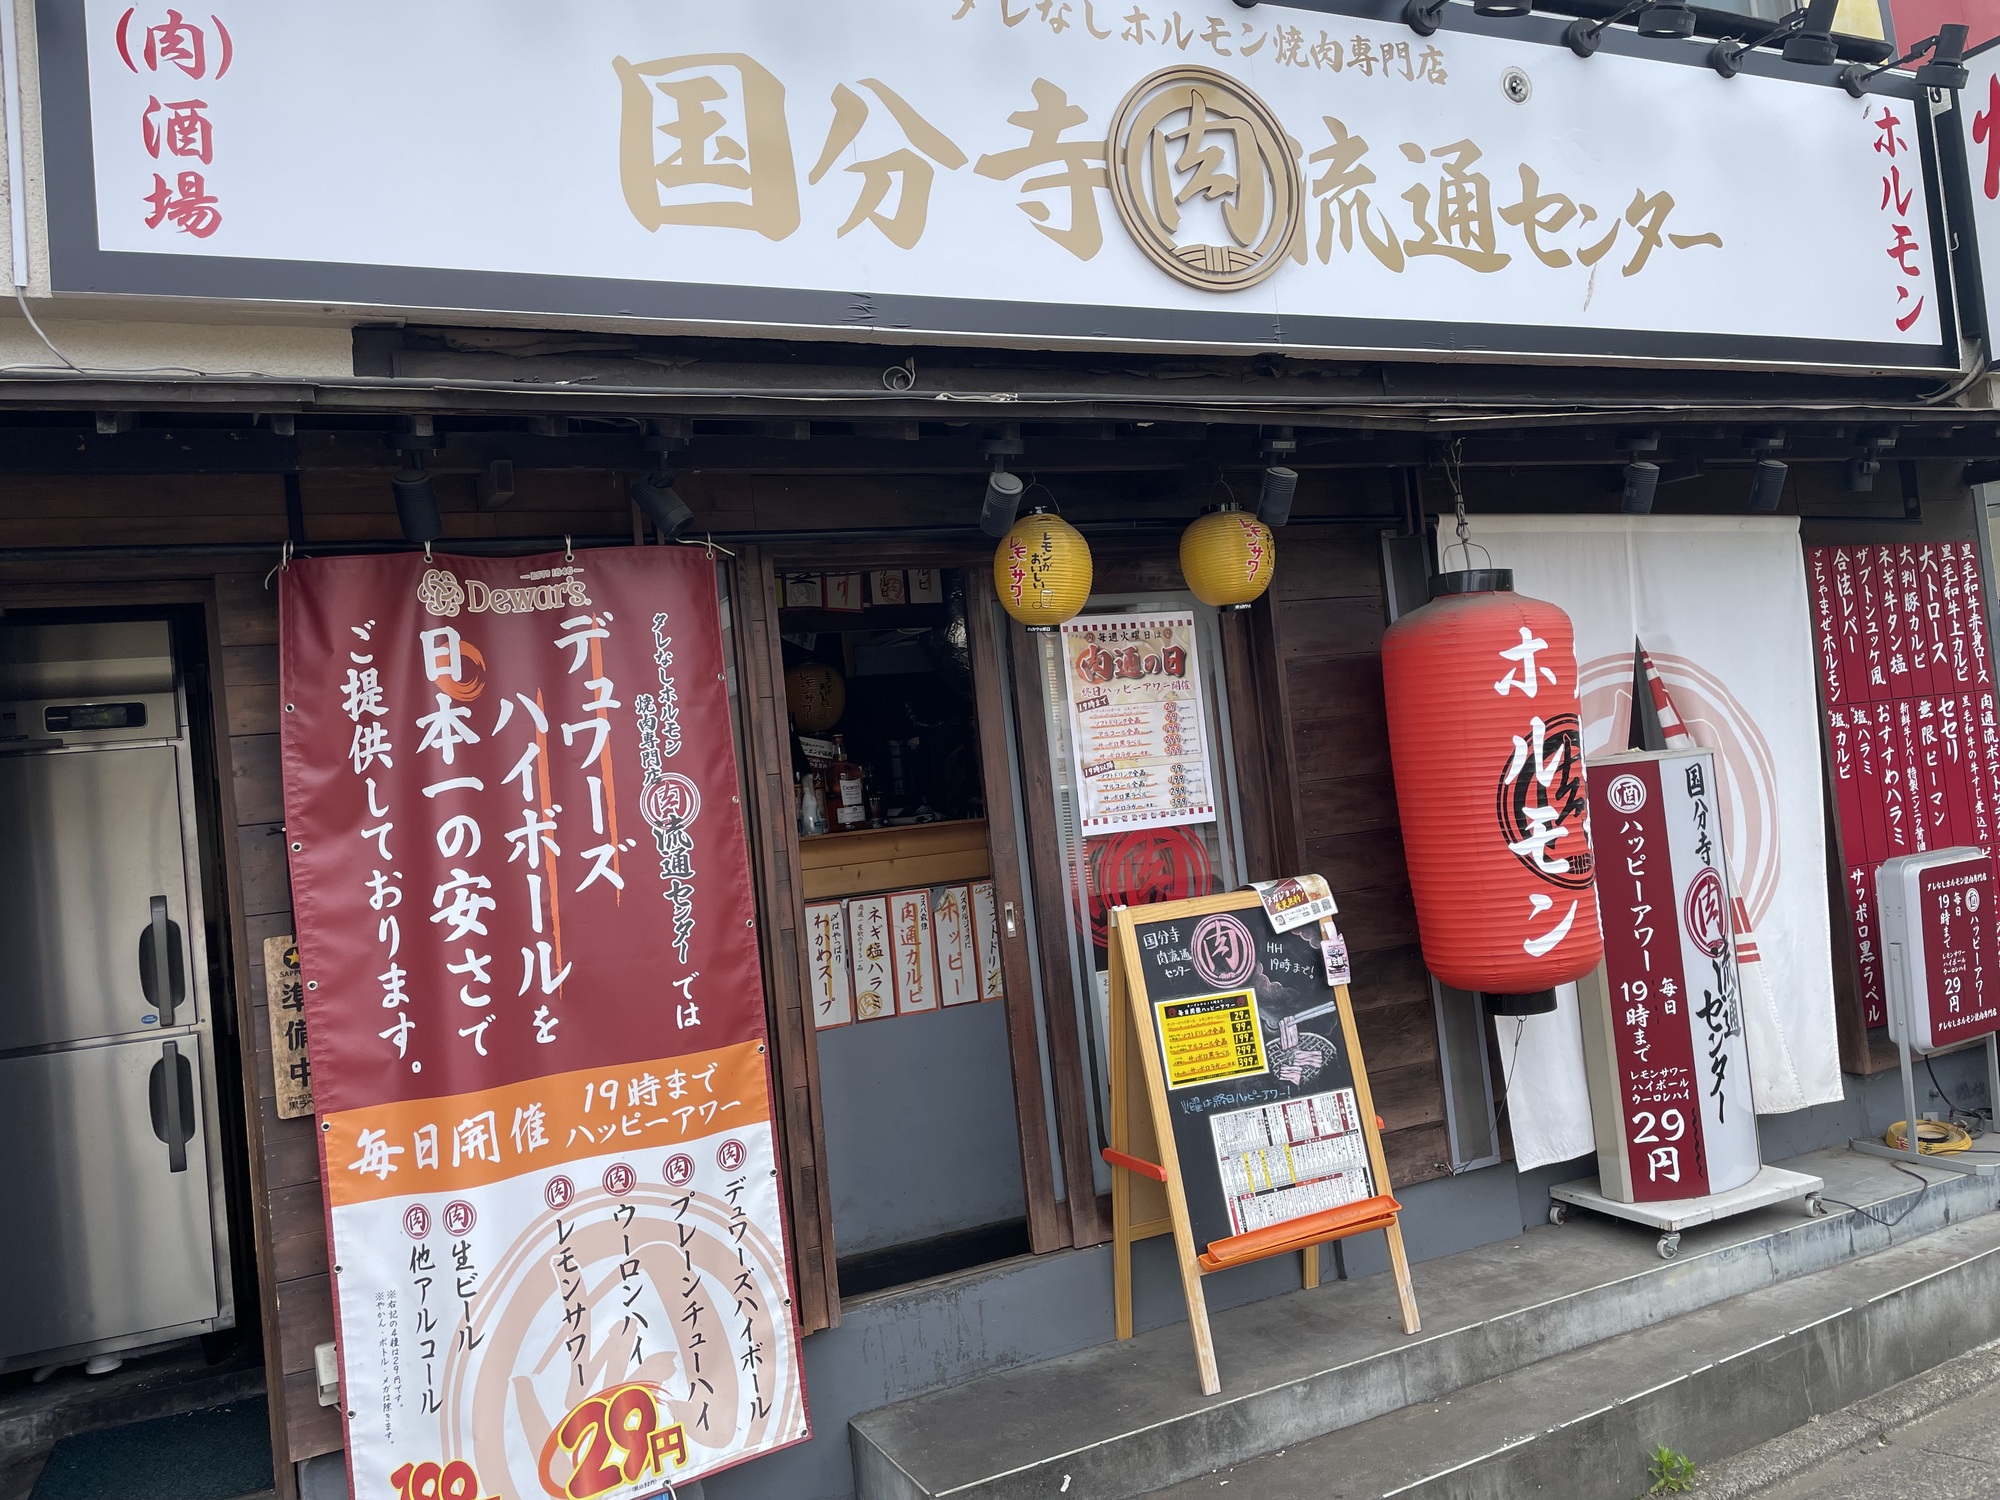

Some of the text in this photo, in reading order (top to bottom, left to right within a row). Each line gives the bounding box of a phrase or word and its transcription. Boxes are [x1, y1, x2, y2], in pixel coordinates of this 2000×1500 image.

[1873, 106, 1925, 332] ホルモン
[552, 566, 573, 577] 1846
[1008, 536, 1027, 607] レモンサワー
[1031, 553, 1045, 589] おいしい
[1041, 532, 1053, 572] レモンが
[1238, 518, 1264, 582] レモンサワー
[1098, 630, 1162, 642] 毎週火曜日は
[1833, 549, 1858, 653] 合法レバー
[1856, 547, 1886, 686] ザブトンユッケ風
[1878, 547, 1908, 675] ネギ牛タン塩
[1899, 545, 1926, 669] 大判豚カルビ
[1919, 545, 1947, 664] 大トロース
[1940, 544, 1969, 682] 黒毛和牛上カルビ
[1961, 543, 1990, 684] 黒毛和牛赤身ロース
[652, 612, 682, 757] タレなしホルモン
[1078, 696, 1108, 711] 19時まで
[1080, 644, 1186, 681] 肉通の日
[1082, 680, 1190, 697] 終日ハッピーアワー開催
[554, 610, 636, 893] デュワーズ
[635, 694, 662, 787] 焼肉専門店
[1877, 704, 1905, 845] おすすめハラミ
[1918, 700, 1945, 826] 無限ピーマン
[1938, 697, 1959, 764] セセリ
[1961, 695, 1988, 840] 黒毛和牛の牛すじ煮込み
[1494, 627, 1578, 957] ホルモン
[1611, 778, 1644, 811] 酒
[341, 619, 422, 1074] ご提供しております。
[416, 627, 496, 1056] 日本一の安さで
[491, 692, 573, 1044] ハイボールを
[1927, 872, 1988, 892] タレなしホルモン焼肉専門店
[1143, 928, 1180, 949] 国分寺
[1620, 820, 1652, 972] ハッピーアワー
[1938, 894, 1950, 949] 19時まで
[1953, 892, 1962, 917] 毎日
[814, 913, 836, 1016] わかめスープ
[866, 906, 884, 1009] ネギ塩ハラミ
[900, 901, 924, 1004] 肉通カルビ
[941, 901, 963, 996] ホッピー
[1157, 948, 1192, 965] 肉流通
[1164, 966, 1191, 979] センター
[1266, 941, 1283, 954] HH
[1850, 868, 1881, 1022] サッポロ黒ラベル
[1970, 916, 1983, 1007] ハッピーアワー
[672, 971, 701, 1030] では
[1620, 980, 1652, 1063] 19時まで
[1658, 977, 1678, 1016] 毎日
[1938, 1007, 1998, 1032] タレなしホルモン焼肉専門店
[1945, 976, 1961, 1013] 29円
[583, 1063, 718, 1114] 19時まで
[1630, 1067, 1688, 1081] レモンサワー
[1632, 1079, 1689, 1093] ハイボール
[1632, 1089, 1690, 1104] ウーロンハイ
[348, 1108, 549, 1181] 毎日開催
[567, 1098, 742, 1148] ハッピーアワー
[1631, 1107, 1685, 1183] 29円
[406, 1208, 443, 1415] 肉 他アルコール
[448, 1204, 484, 1352] 肉 生ビール
[548, 1178, 587, 1387] 肉 レモンサワー
[606, 1166, 649, 1366] 肉 ウーロンハイ
[666, 1157, 714, 1431] 肉 プレーンチューハイ
[720, 1142, 772, 1422] 肉 デュワーズハイボール
[558, 1385, 688, 1500] 29円
